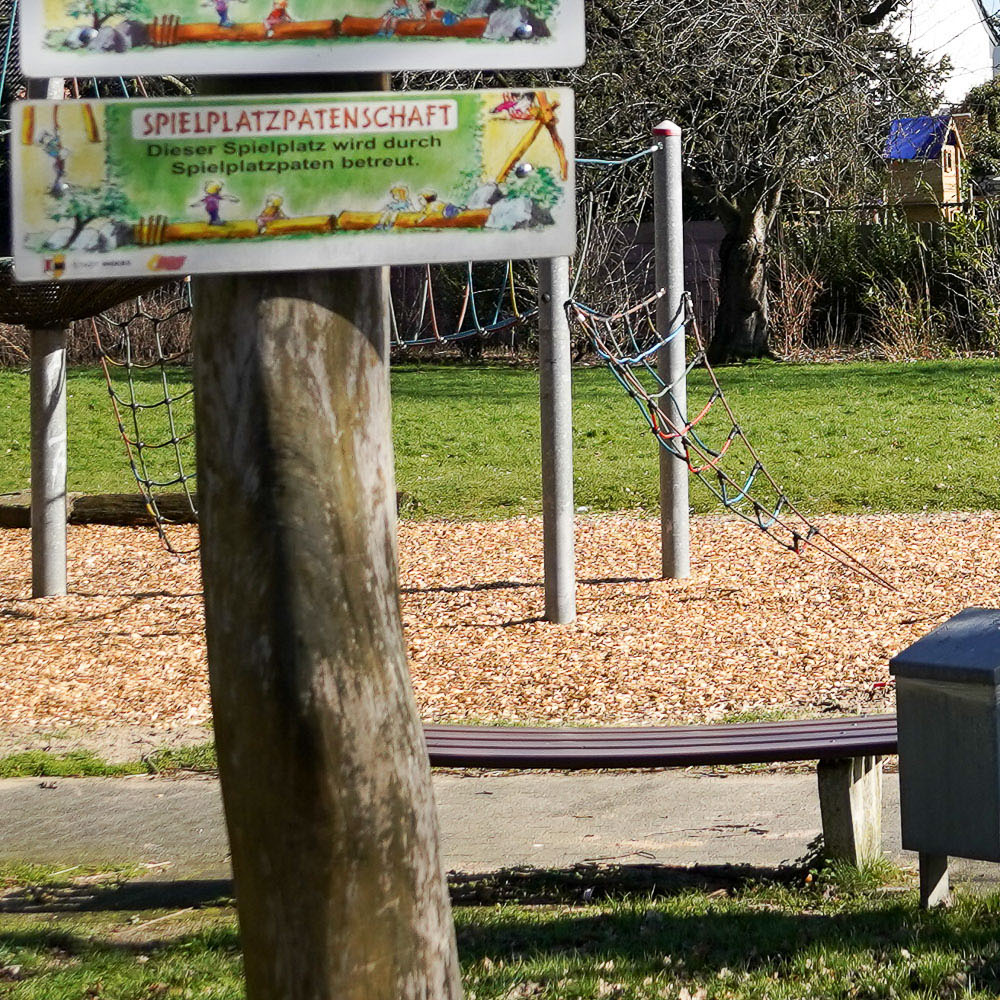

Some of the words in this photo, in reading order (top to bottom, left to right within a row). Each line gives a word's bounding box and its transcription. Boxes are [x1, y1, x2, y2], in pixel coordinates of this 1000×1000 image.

[143, 104, 453, 136] SPIELPLATZPATENSCHAFT
[147, 143, 216, 157] Dieser
[223, 139, 325, 157] Spielplatz
[332, 137, 376, 151] wird
[383, 135, 442, 149] durch
[171, 157, 334, 177] Spielplatzpaten
[341, 154, 420, 169] betreut.
